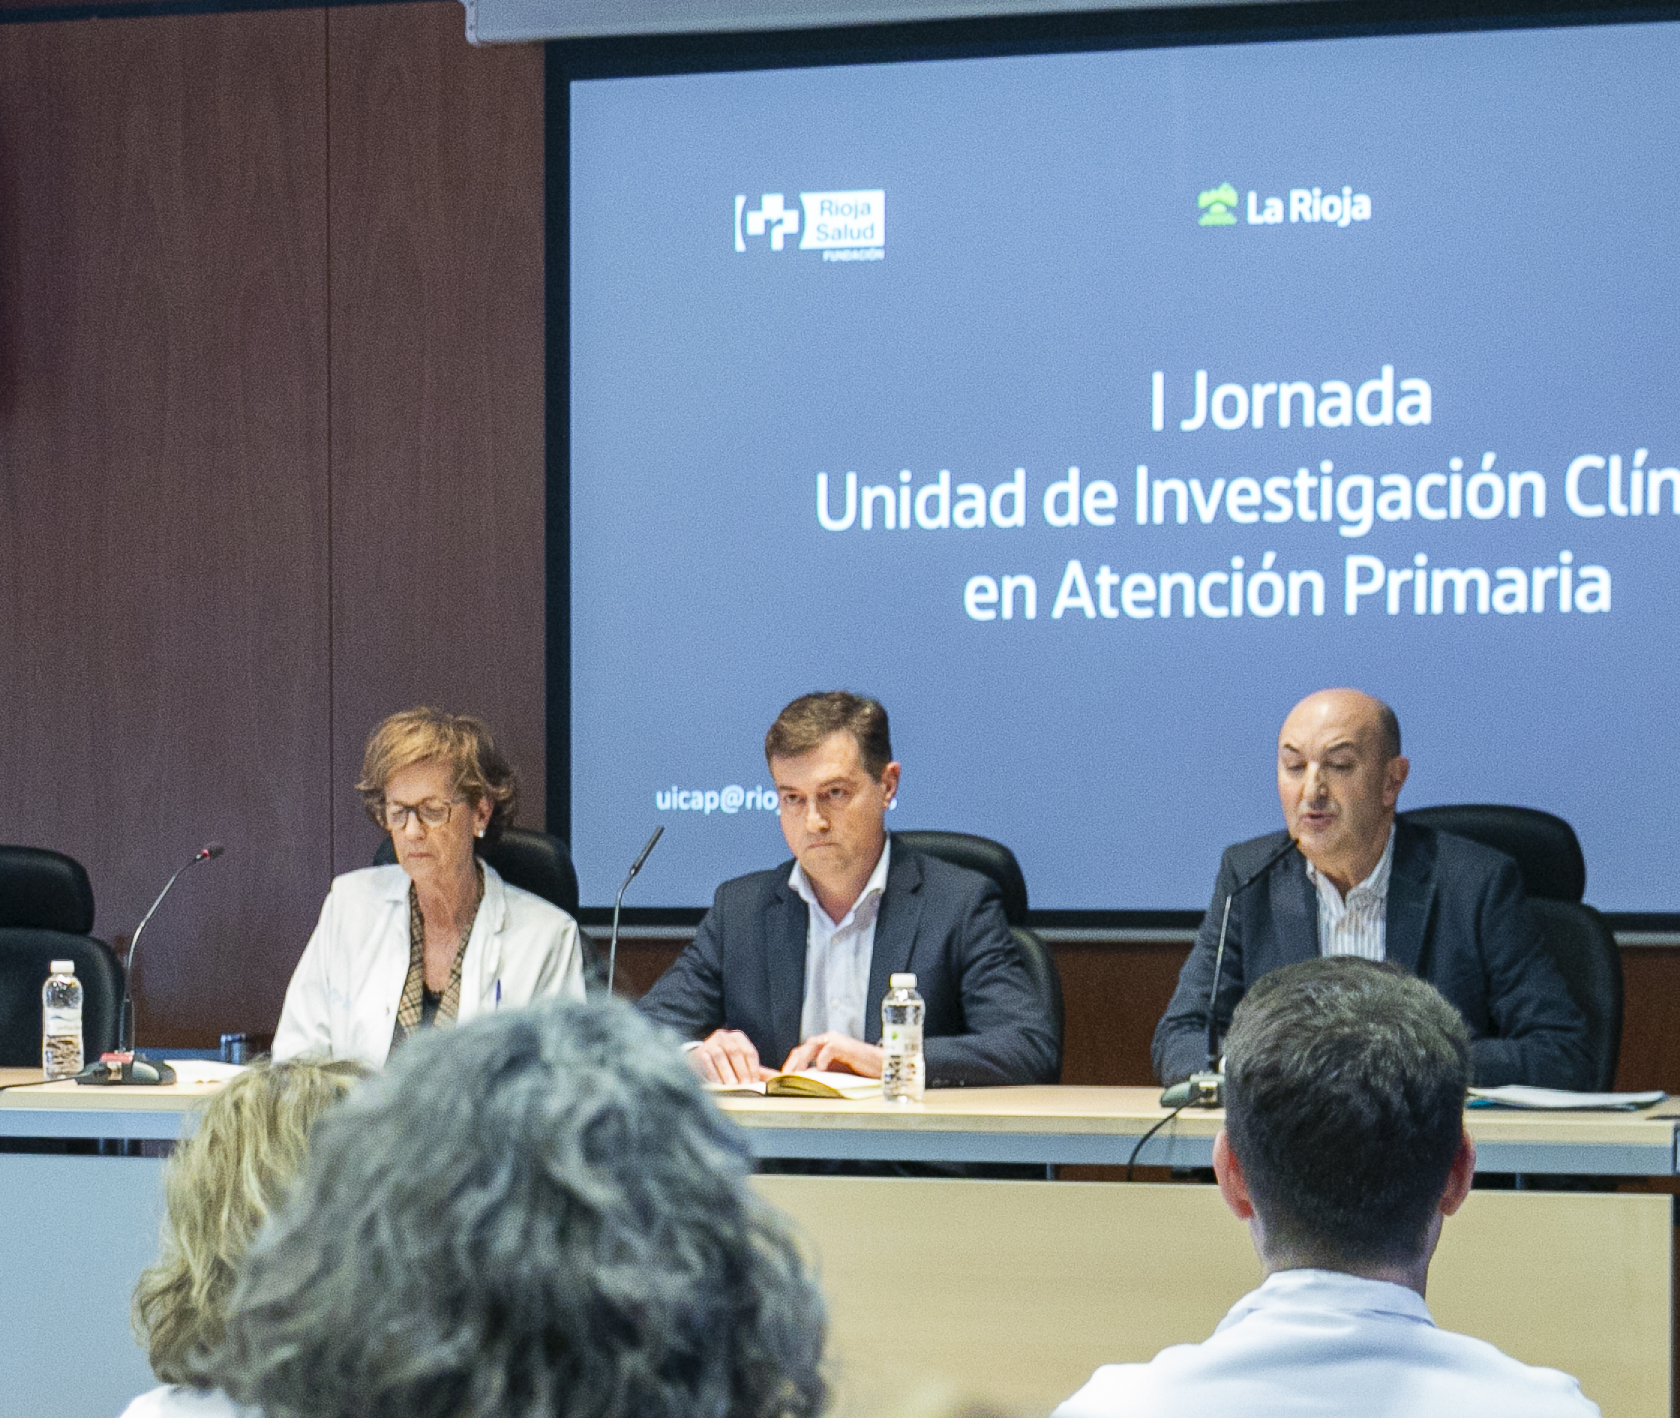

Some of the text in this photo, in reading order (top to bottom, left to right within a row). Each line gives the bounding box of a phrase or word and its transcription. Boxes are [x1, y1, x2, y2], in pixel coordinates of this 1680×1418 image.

[815, 223, 876, 242] Salud
[819, 198, 872, 220] Rioja
[1247, 186, 1373, 229] La Rioja
[1152, 364, 1433, 433] I Jornada
[816, 468, 1027, 532] Unidad
[1043, 465, 1120, 528] de
[1135, 450, 1548, 538] Investigación
[963, 549, 1613, 622] en Atención Primaria
